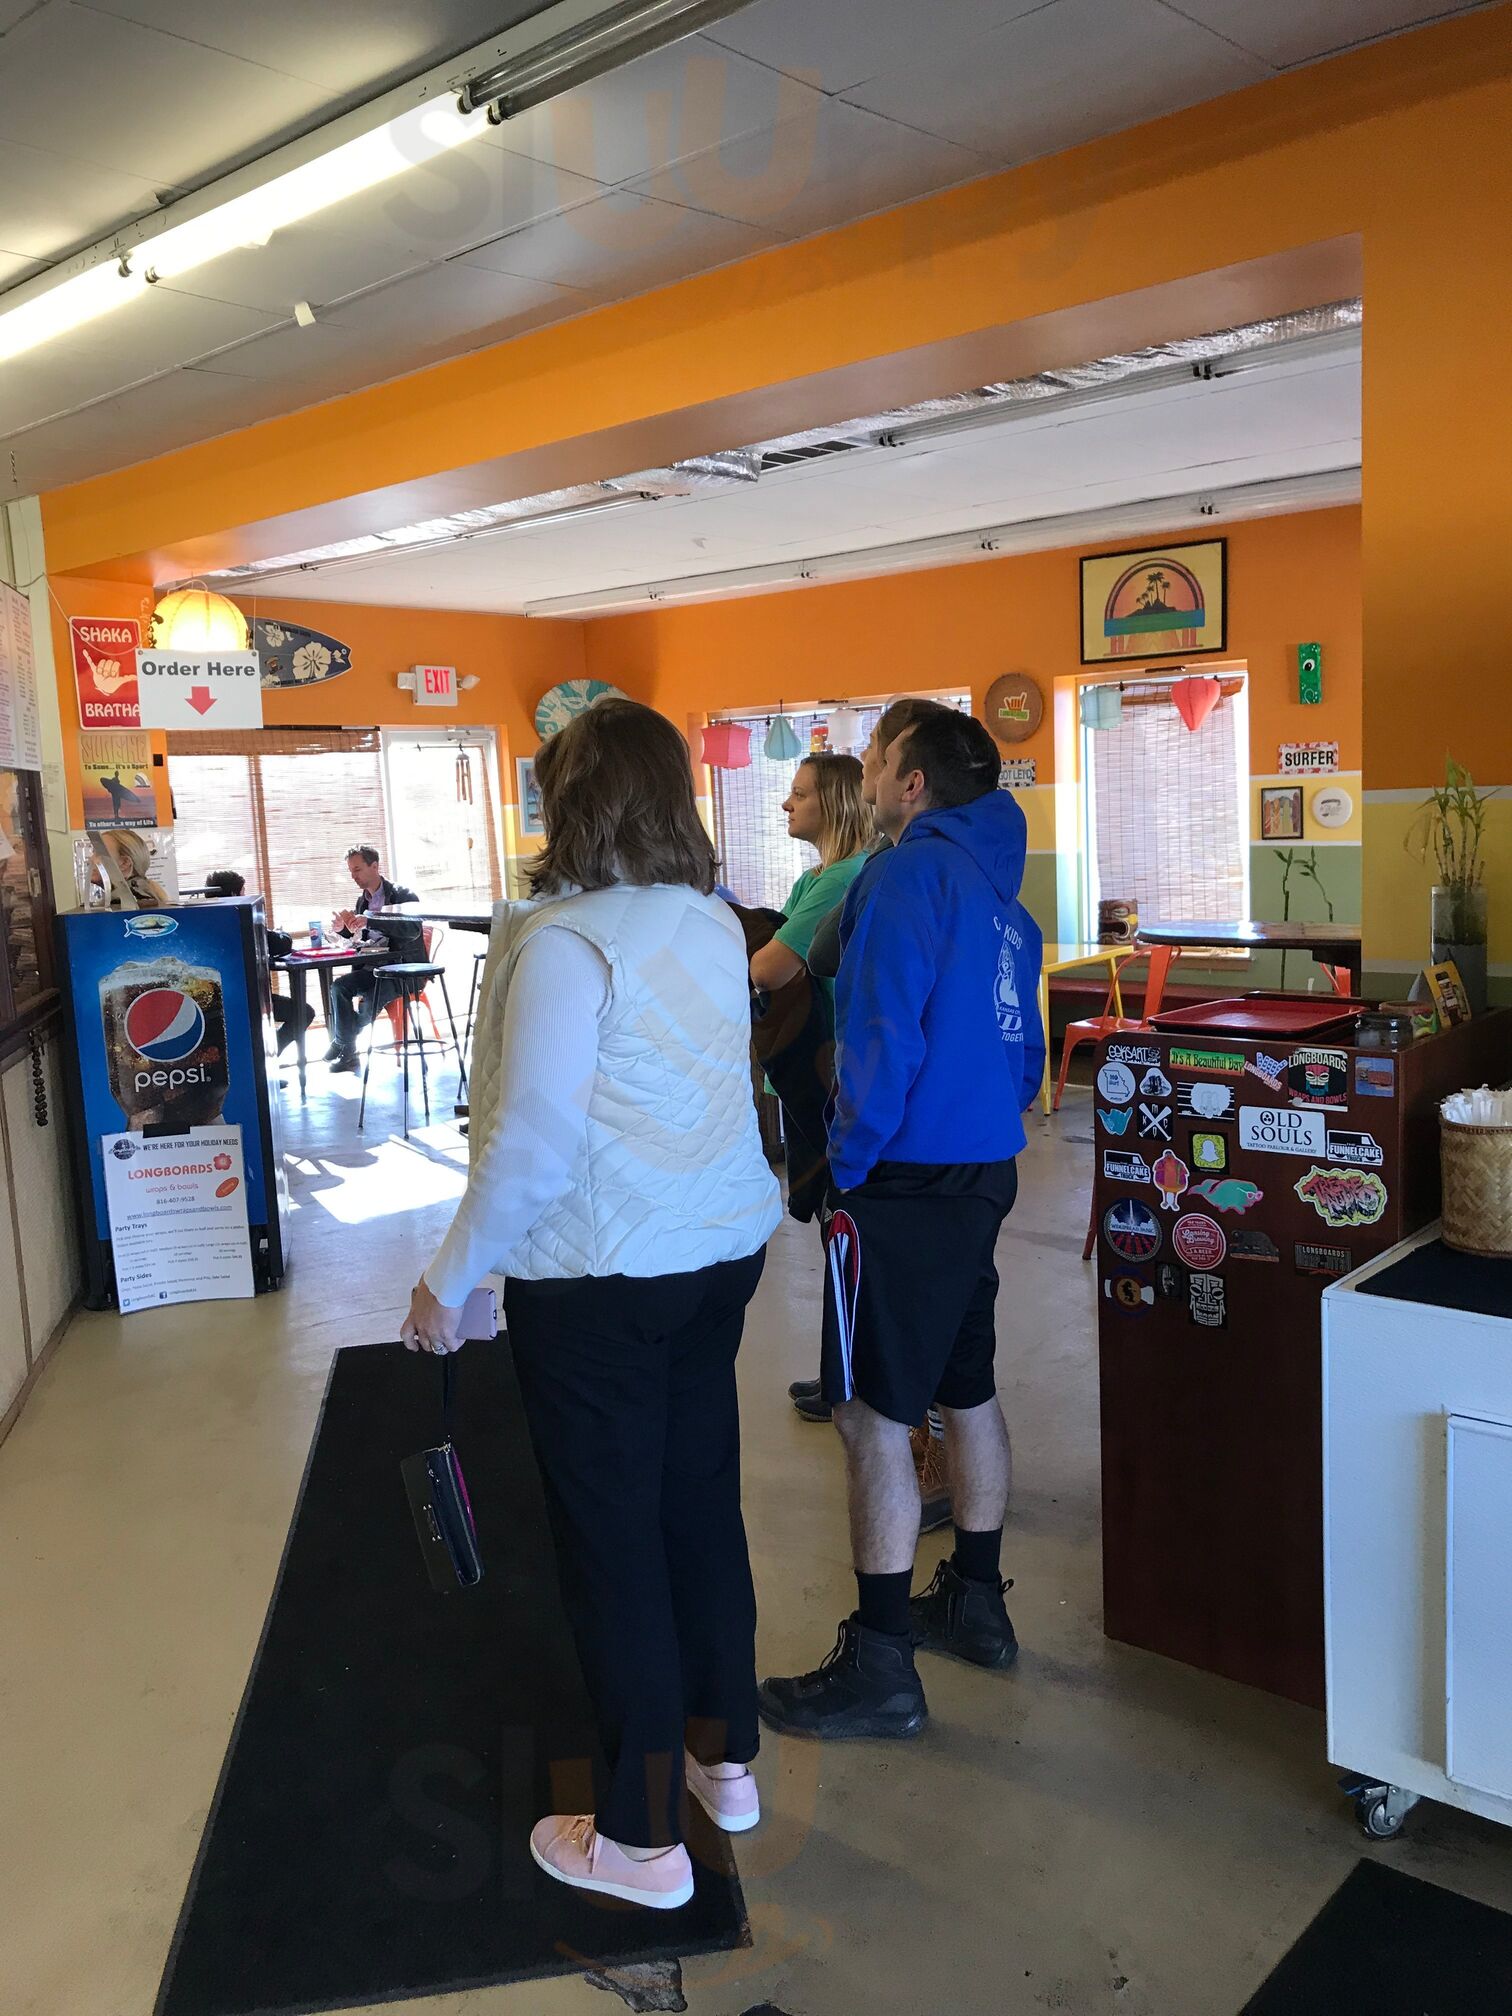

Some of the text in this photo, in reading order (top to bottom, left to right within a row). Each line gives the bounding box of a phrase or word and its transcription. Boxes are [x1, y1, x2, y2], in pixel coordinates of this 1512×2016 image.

[80, 626, 132, 643] SHAKA
[141, 661, 256, 676] Order Here
[424, 668, 450, 694] EXIT
[85, 703, 141, 717] BRATHA
[1284, 751, 1334, 766] SURFER
[1003, 924, 1023, 950] KIDS
[1193, 1054, 1226, 1070] Beautiful
[1228, 1057, 1243, 1074] Day
[1288, 1052, 1347, 1072] LONGBOARDS
[134, 1063, 206, 1092] pepsi
[1244, 1060, 1283, 1090] LONGBOARDS
[1310, 1096, 1324, 1104] AND
[1325, 1093, 1347, 1104] BOWLS
[1260, 1110, 1303, 1128] OLD
[1251, 1125, 1312, 1146] SOULS
[143, 1138, 239, 1151] WE'RE HERE FOR YOUR HOLIDAY NEEDS
[128, 1163, 213, 1180] LONGBOARDS
[177, 1182, 199, 1191] bowls
[115, 1222, 148, 1232] Party Trays
[1302, 1246, 1345, 1258] LONGBOARDS
[120, 1275, 136, 1283] Party
[136, 1272, 153, 1281] Sides
